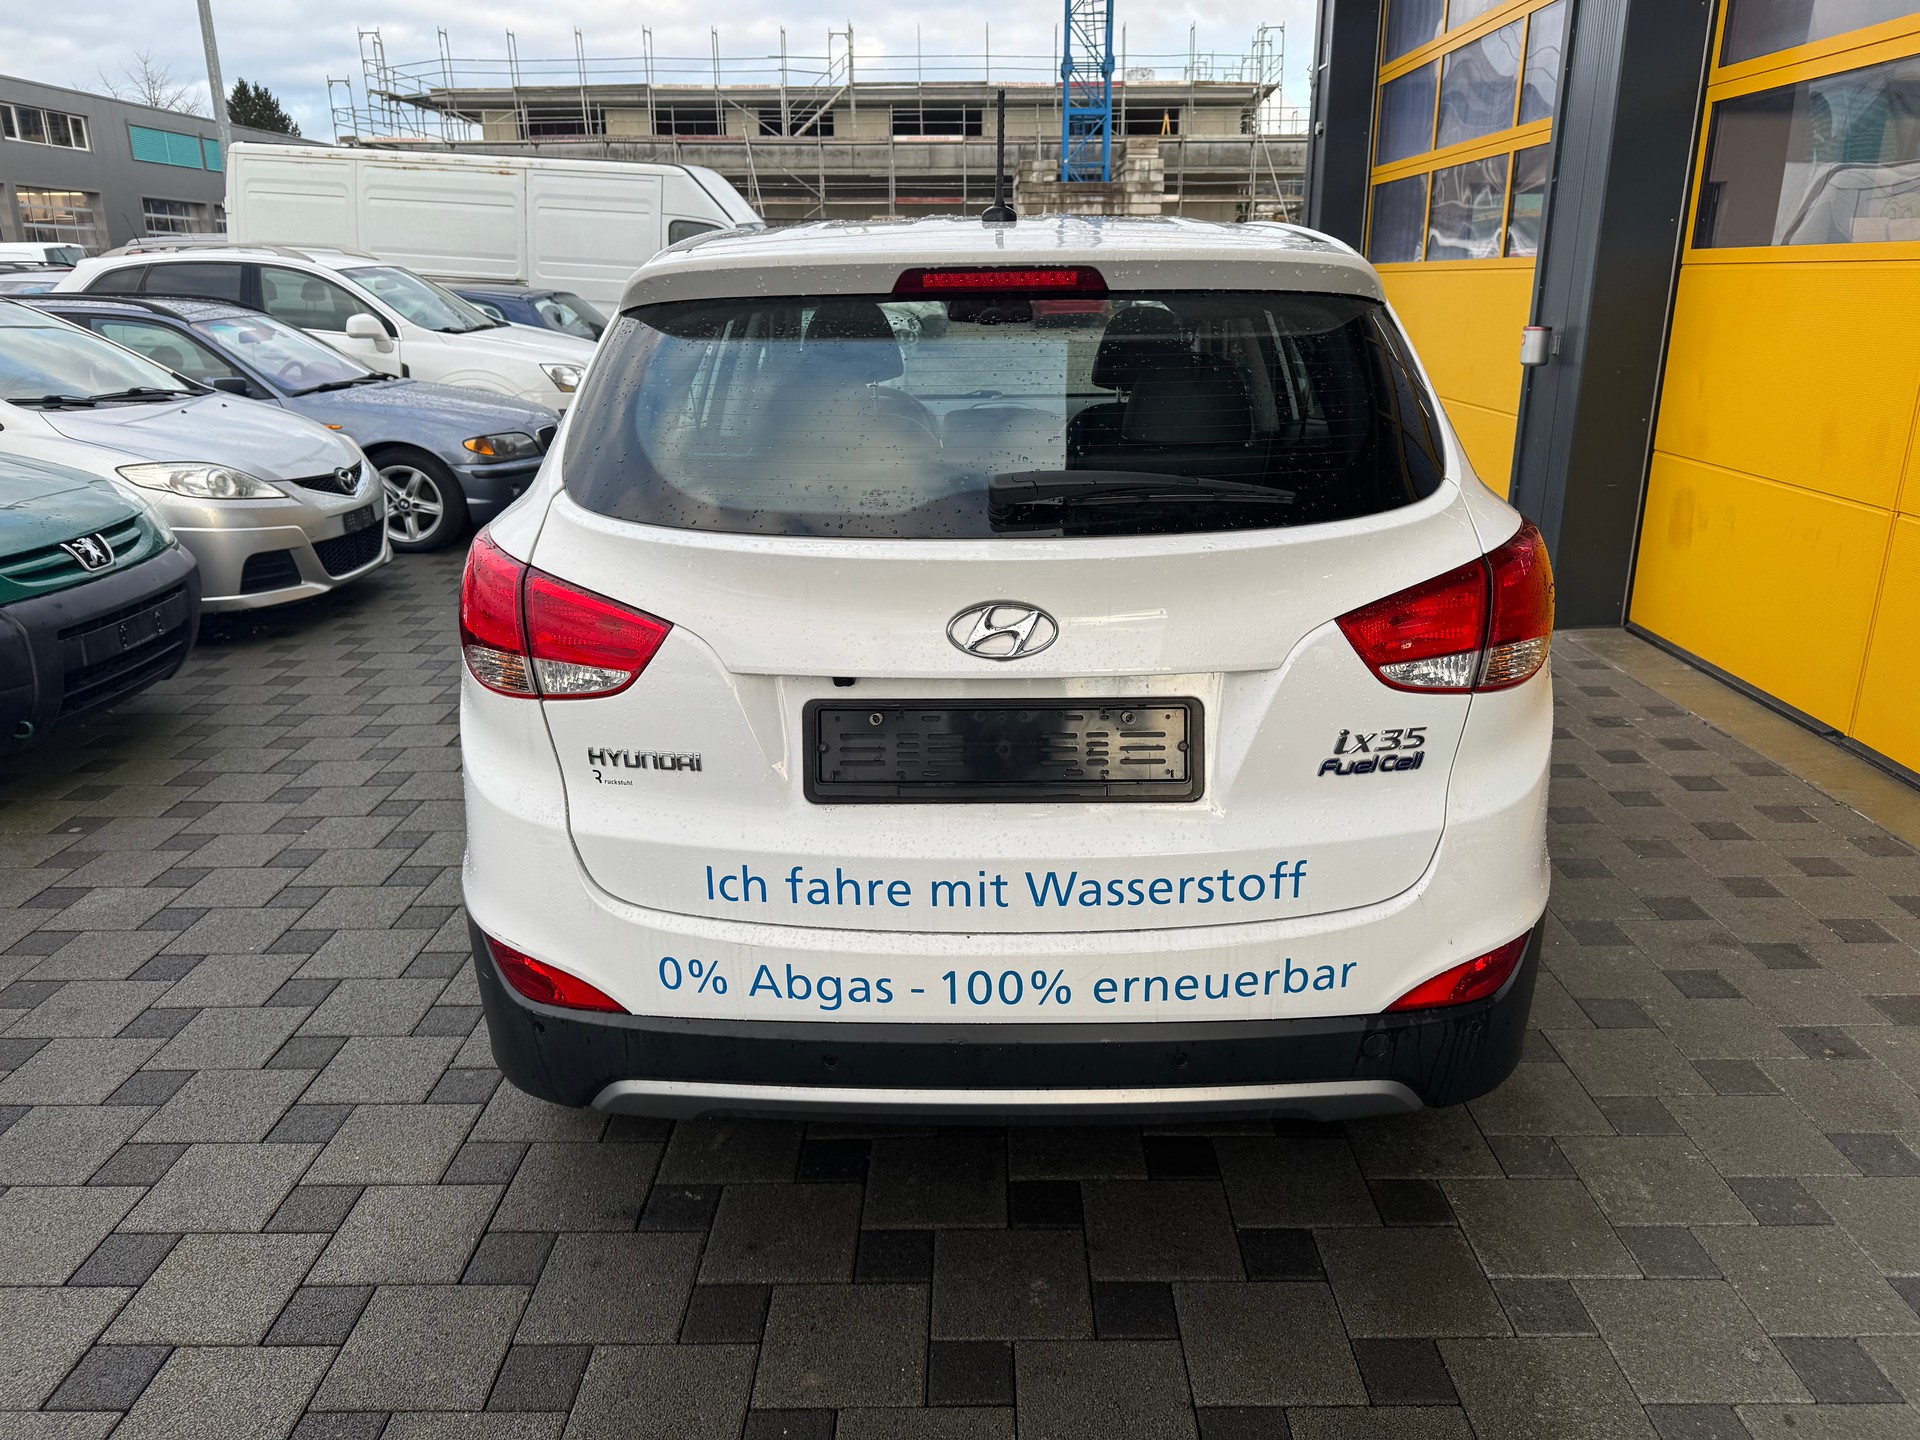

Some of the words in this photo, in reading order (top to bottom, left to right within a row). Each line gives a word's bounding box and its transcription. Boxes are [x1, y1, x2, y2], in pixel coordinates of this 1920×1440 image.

[1333, 727, 1428, 755] ix35
[706, 864, 768, 903] Ich
[785, 865, 912, 908] fahre
[931, 870, 1009, 909] mit
[1025, 859, 1308, 908] Wasserstoff
[658, 956, 729, 995] 0%
[749, 963, 894, 1011] Abgas
[943, 969, 1072, 1006] 100%
[1093, 959, 1357, 1005] erneuerbar
